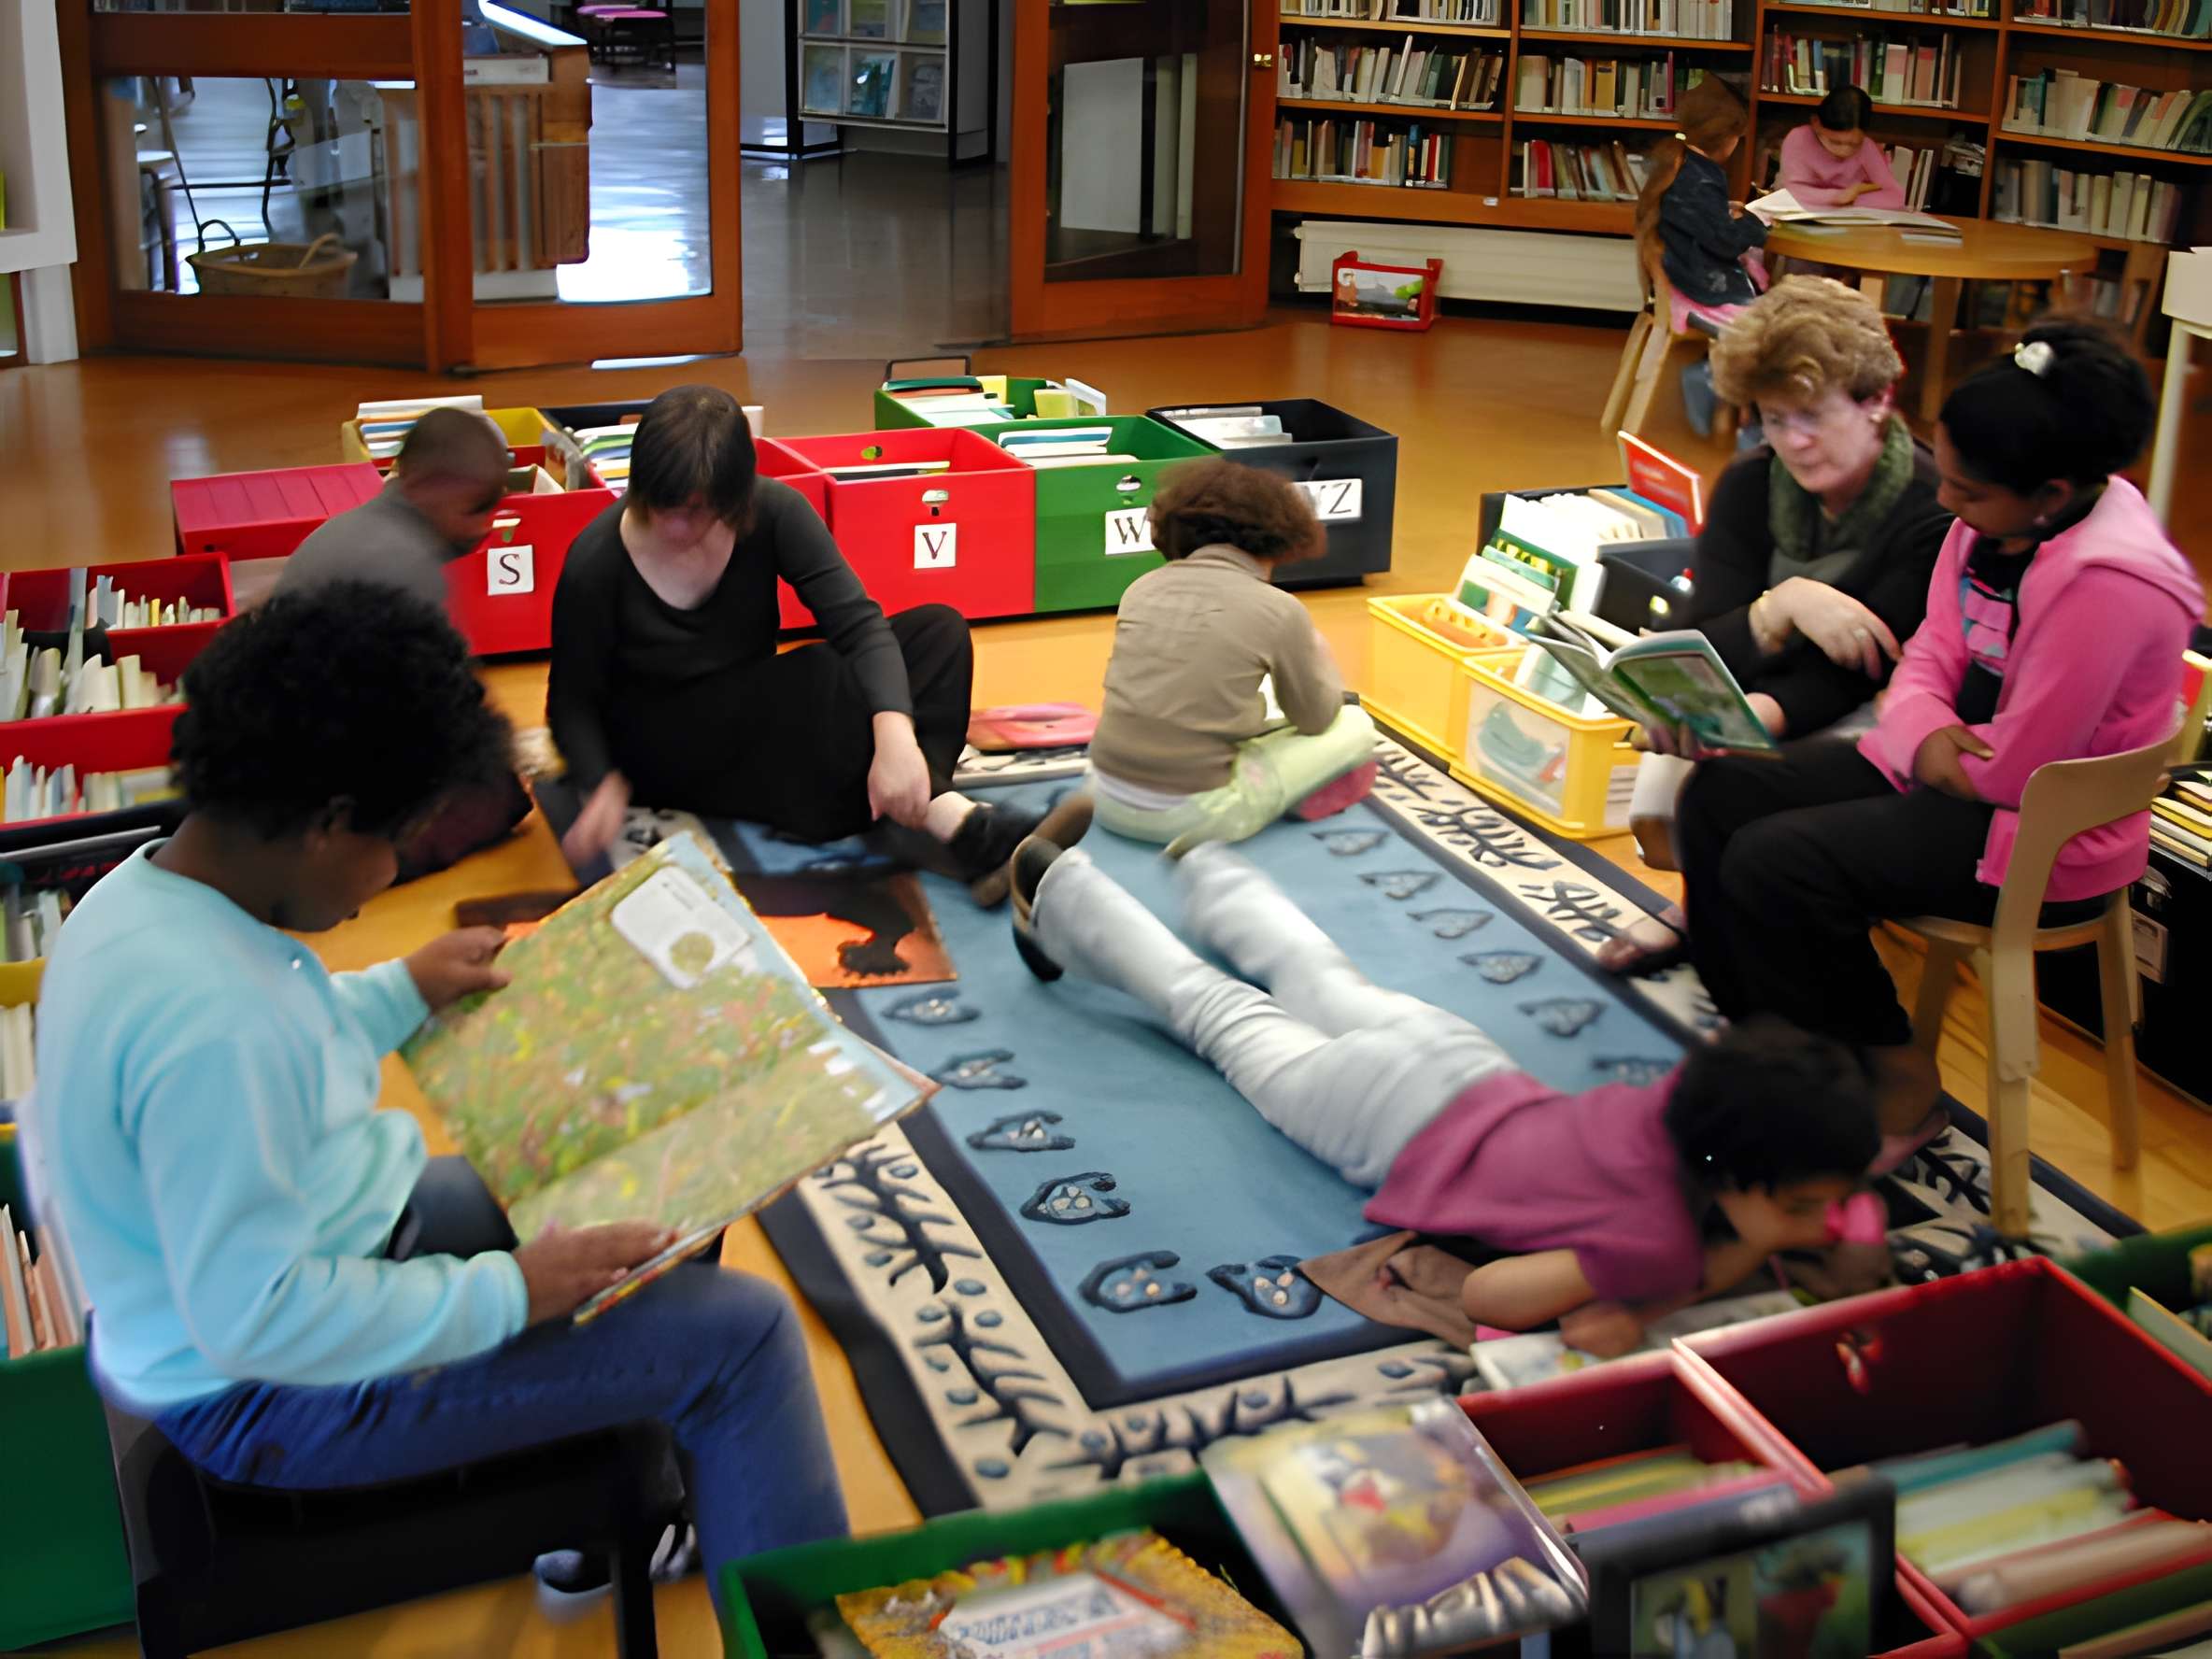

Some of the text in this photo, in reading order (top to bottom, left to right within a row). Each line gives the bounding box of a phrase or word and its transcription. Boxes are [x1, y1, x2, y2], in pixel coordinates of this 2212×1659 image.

[1114, 516, 1148, 545] W
[922, 531, 947, 560] V
[499, 553, 520, 586] S
